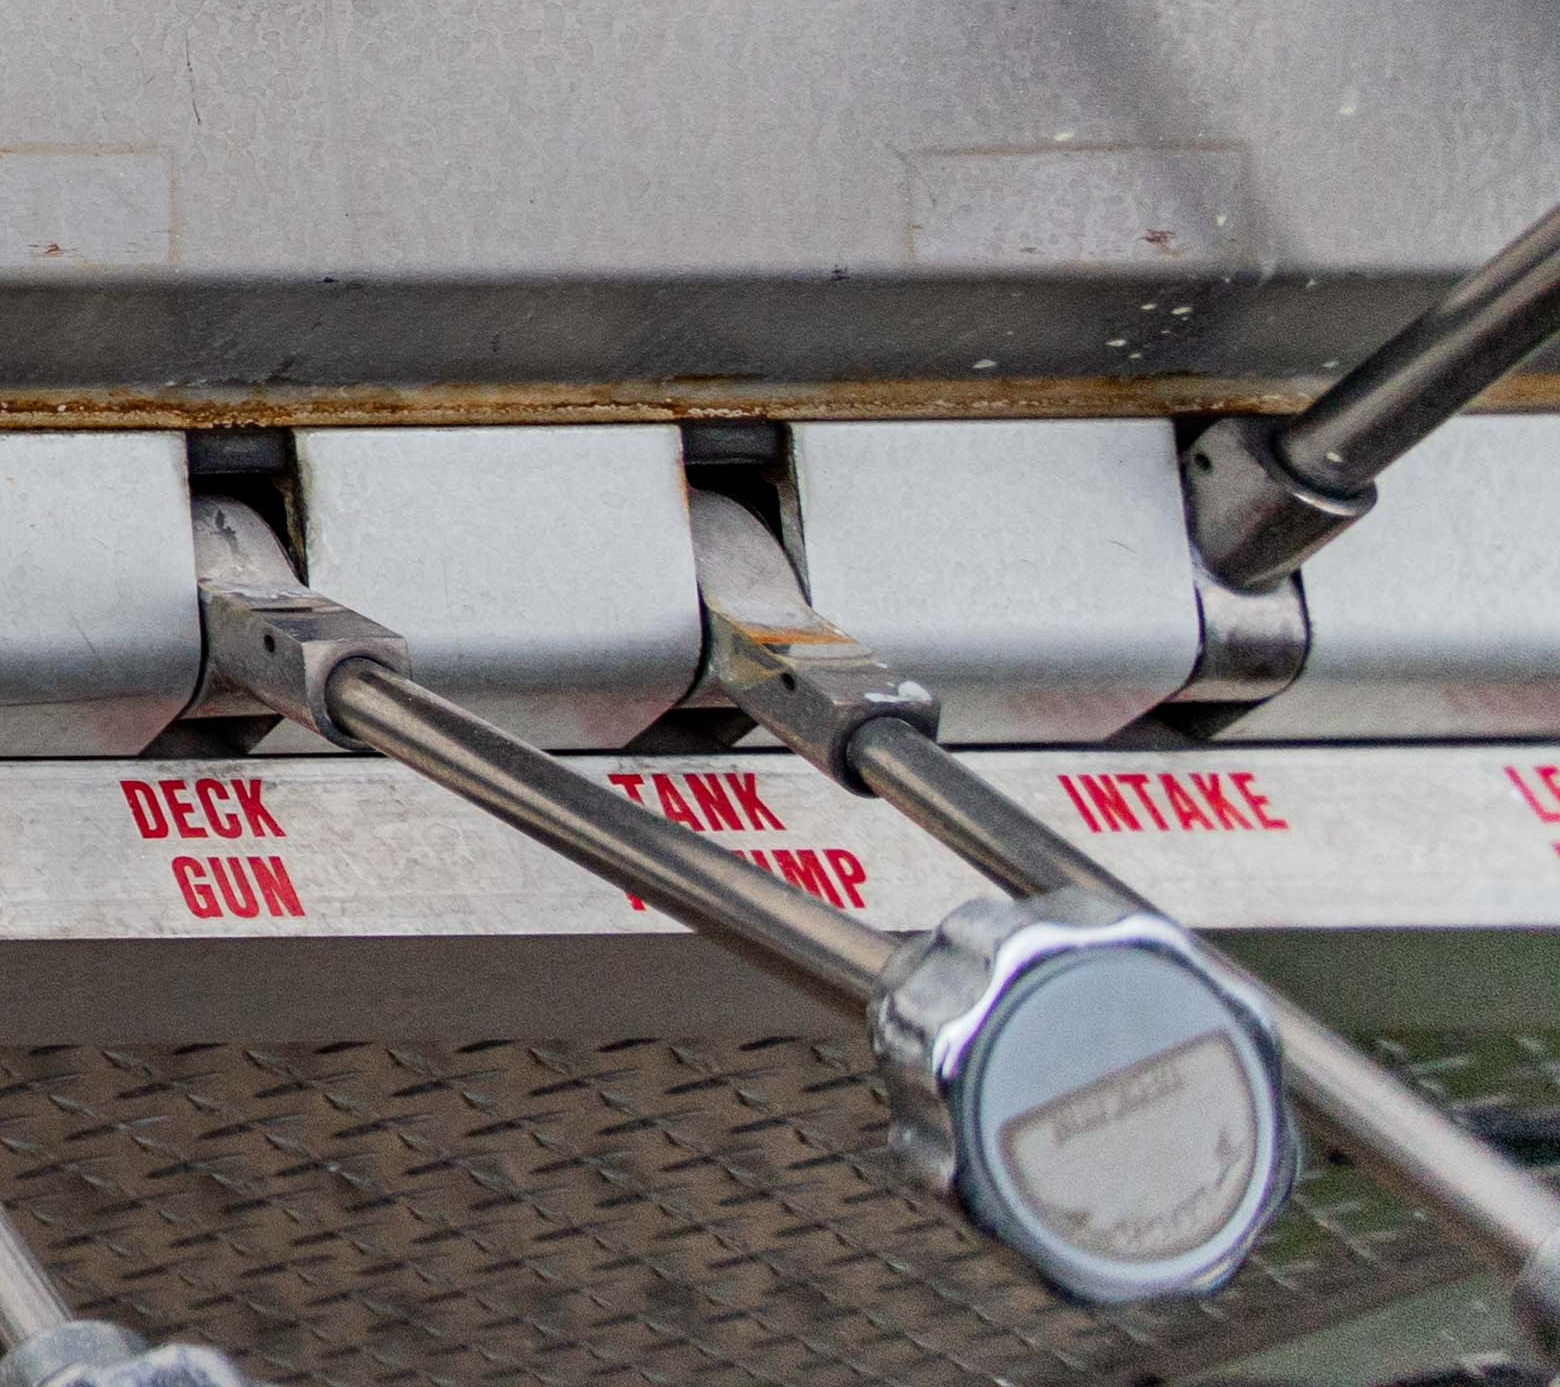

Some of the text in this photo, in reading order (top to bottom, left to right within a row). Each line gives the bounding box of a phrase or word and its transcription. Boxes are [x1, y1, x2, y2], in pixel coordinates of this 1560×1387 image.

[120, 778, 286, 839] DECK
[607, 772, 787, 832] TANK
[1058, 772, 1289, 833] INTAKE
[171, 855, 306, 919] GUN
